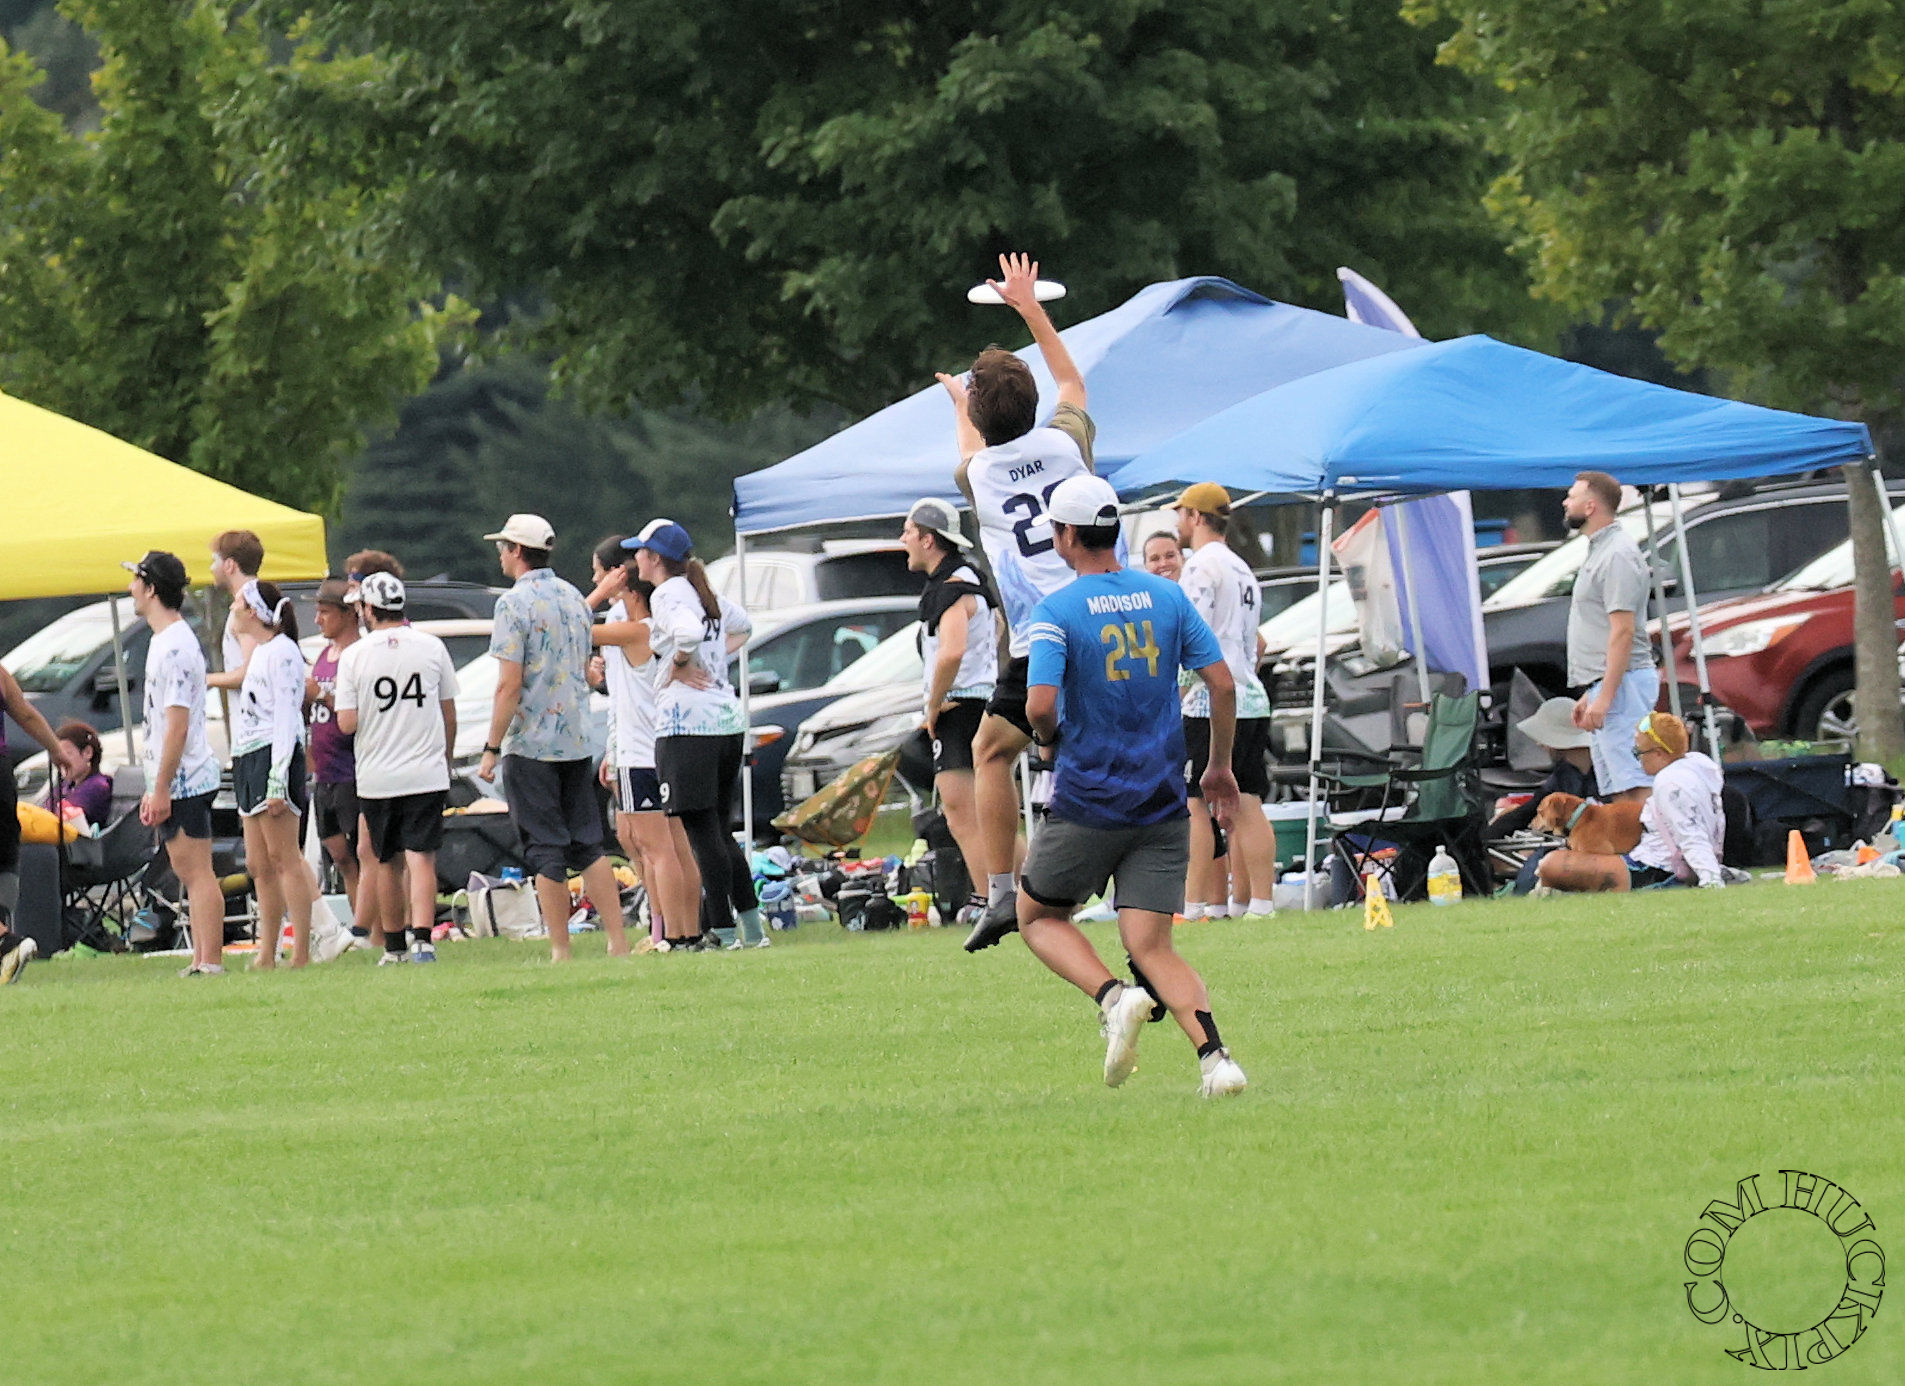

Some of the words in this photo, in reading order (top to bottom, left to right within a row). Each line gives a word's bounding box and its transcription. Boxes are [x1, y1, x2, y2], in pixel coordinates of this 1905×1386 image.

[1009, 460, 1045, 482] DYAR
[1002, 478, 1067, 558] 2
[1086, 590, 1153, 615] MADISON
[1100, 620, 1160, 682] 24
[374, 672, 426, 713] 94
